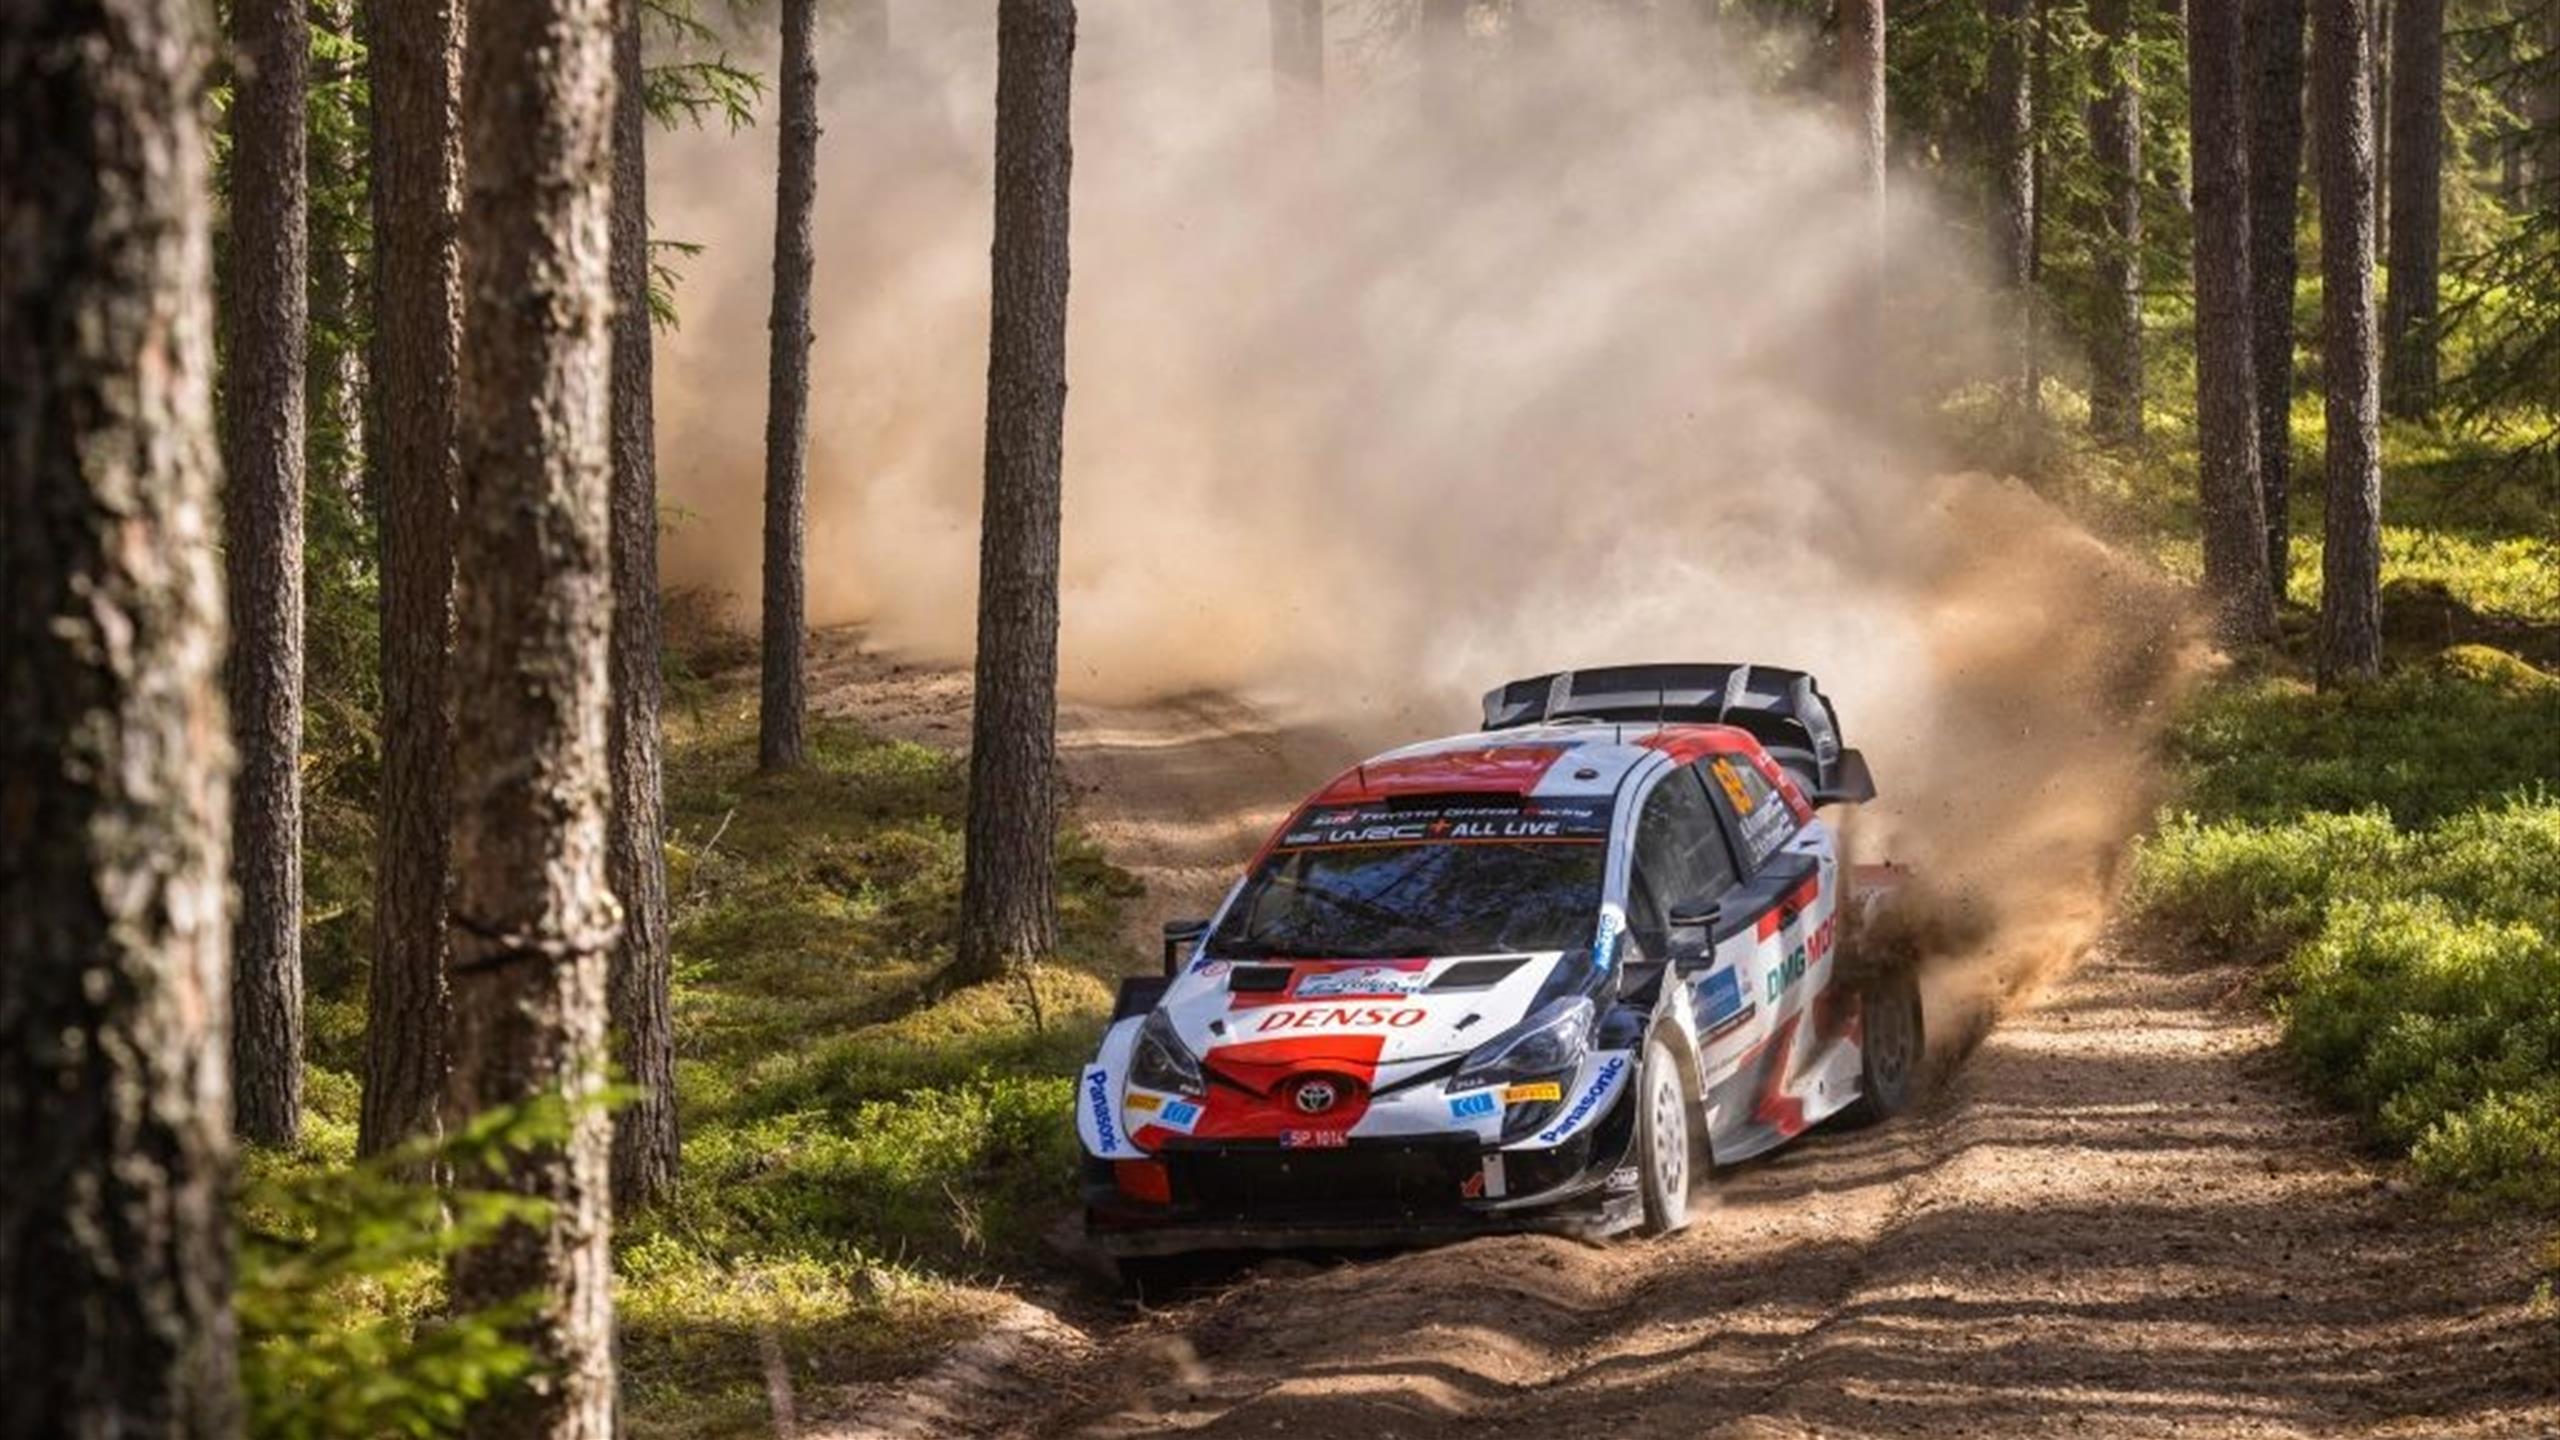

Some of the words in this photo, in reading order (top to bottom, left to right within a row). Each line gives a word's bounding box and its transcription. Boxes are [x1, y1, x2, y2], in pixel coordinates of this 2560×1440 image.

[1329, 824, 1426, 842] WRC
[1451, 822, 1496, 837] ALL
[1504, 821, 1560, 836] LIVE
[1767, 944, 1805, 1004] DMG
[1257, 1008, 1427, 1033] DENSO
[1087, 1070, 1121, 1152] Panasonic
[1539, 1056, 1625, 1142] Panasonic
